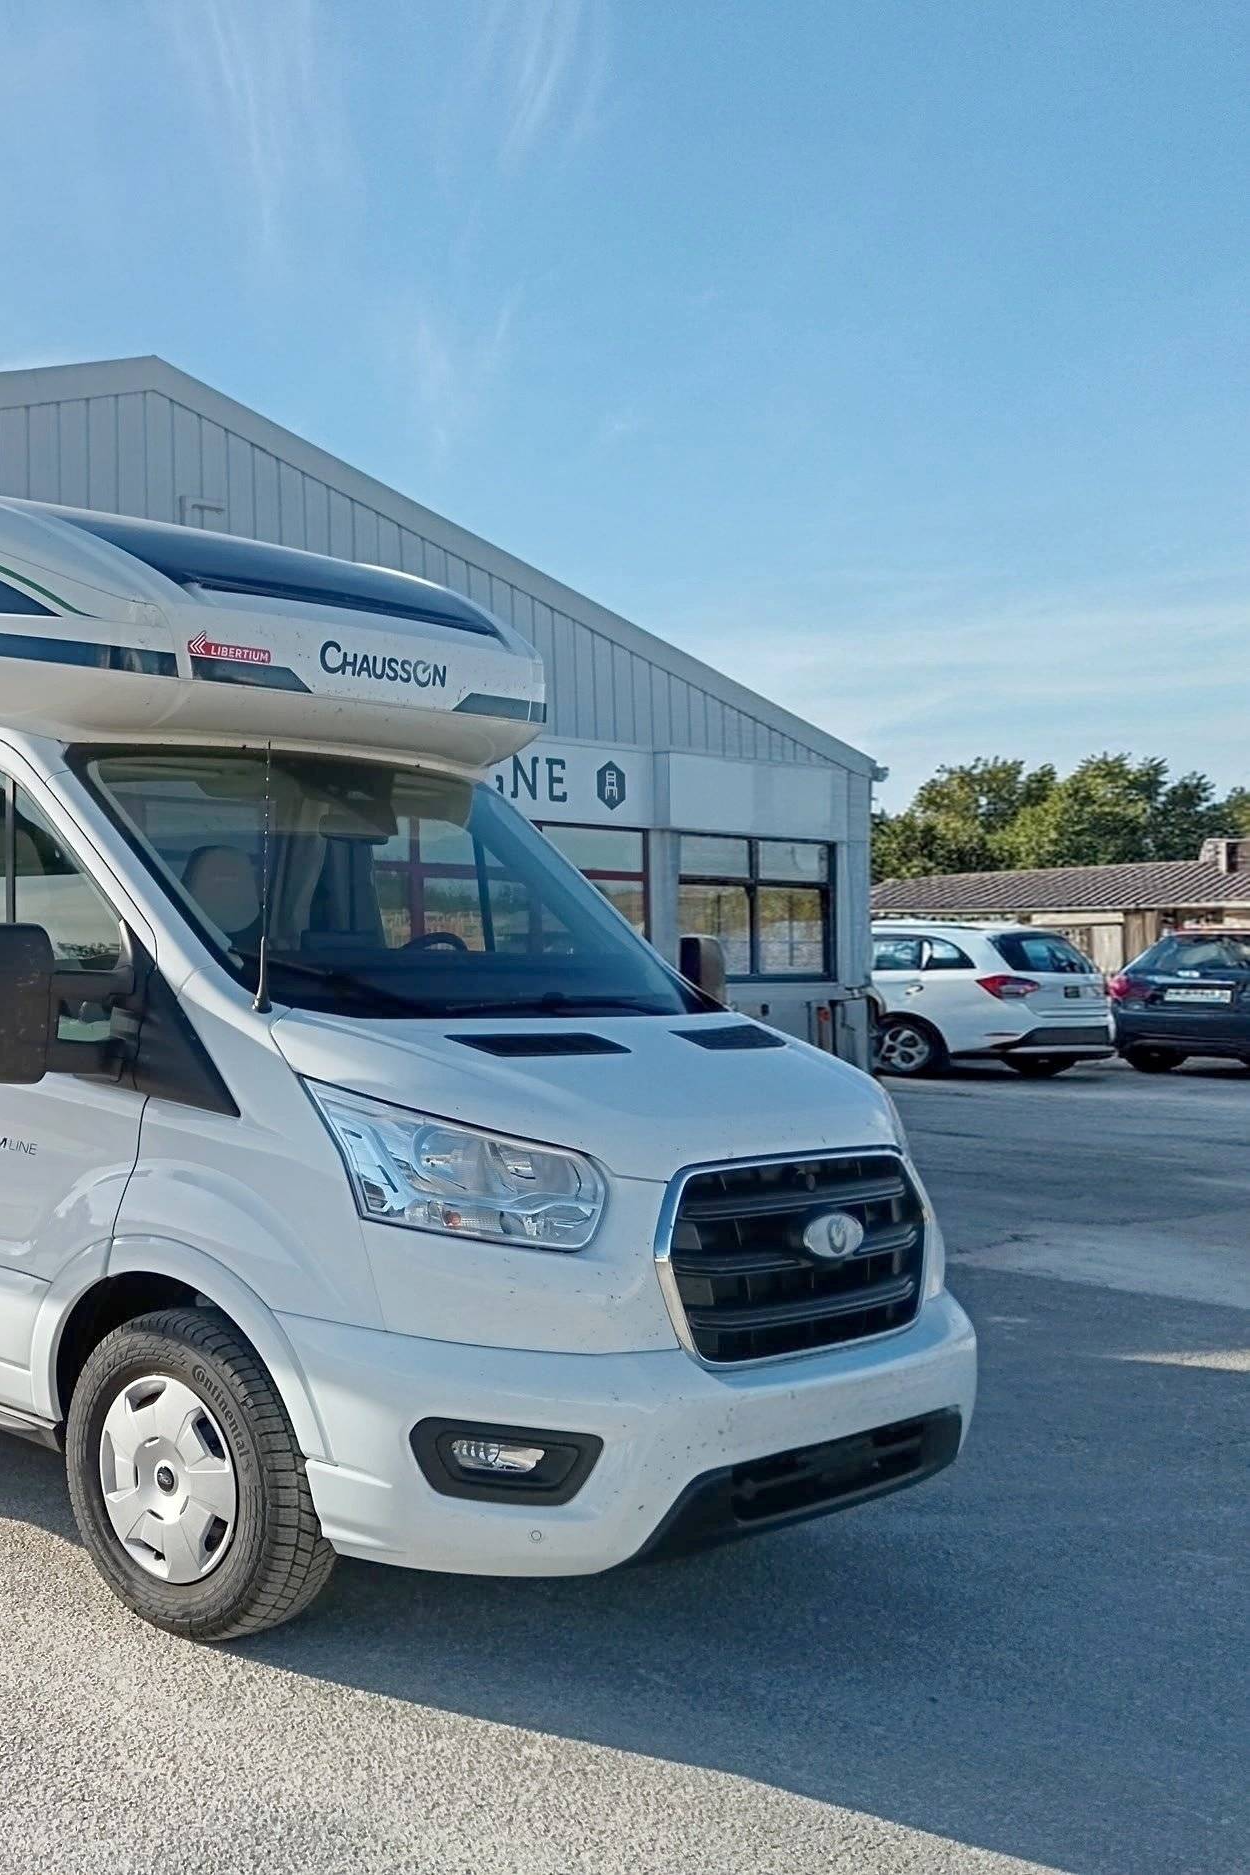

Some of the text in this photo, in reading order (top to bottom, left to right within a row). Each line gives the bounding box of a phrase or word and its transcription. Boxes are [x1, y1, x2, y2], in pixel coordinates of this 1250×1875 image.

[210, 645, 269, 662] LIBERTIUM
[319, 640, 447, 688] CHAUSSON
[192, 1364, 250, 1458] Continental
